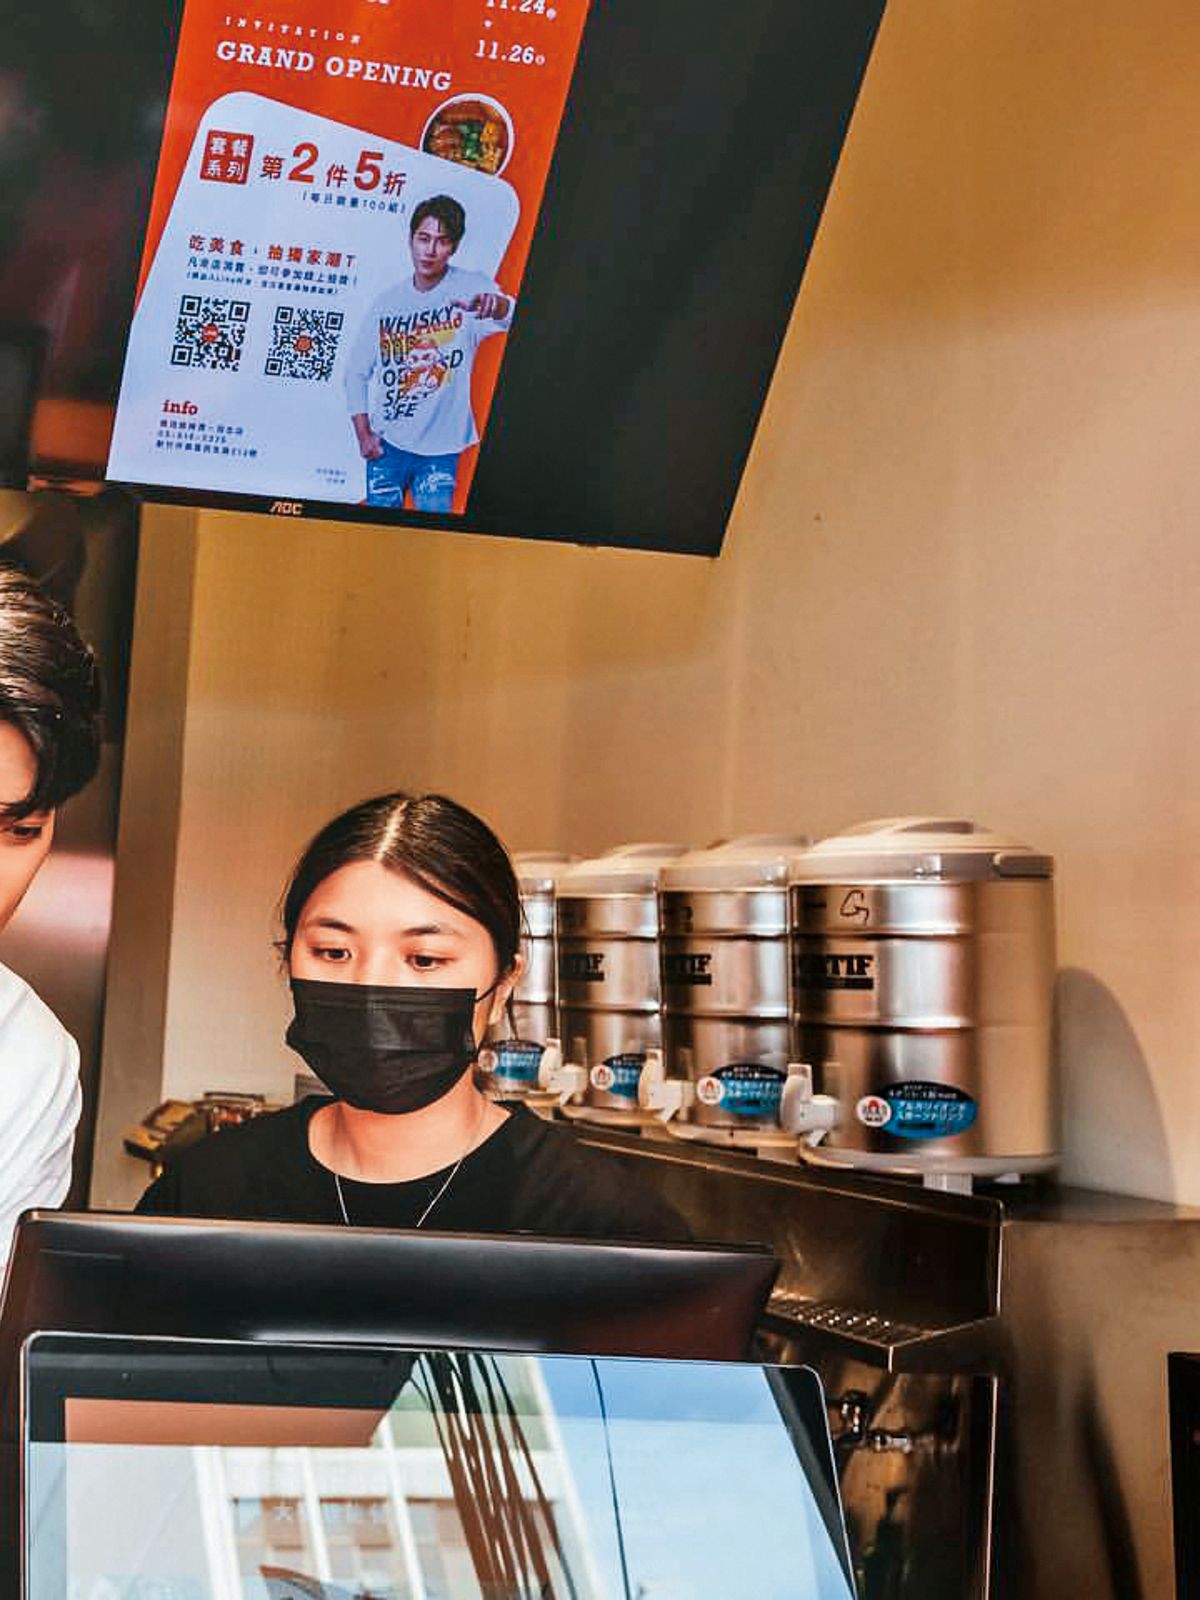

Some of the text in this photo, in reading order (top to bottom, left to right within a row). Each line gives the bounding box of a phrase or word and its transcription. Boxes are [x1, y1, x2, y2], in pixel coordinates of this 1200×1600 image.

[225, 16, 361, 45] INVITATION
[216, 40, 453, 90] GRAND OPENING
[162, 400, 198, 415] info
[269, 501, 303, 515] AOC
